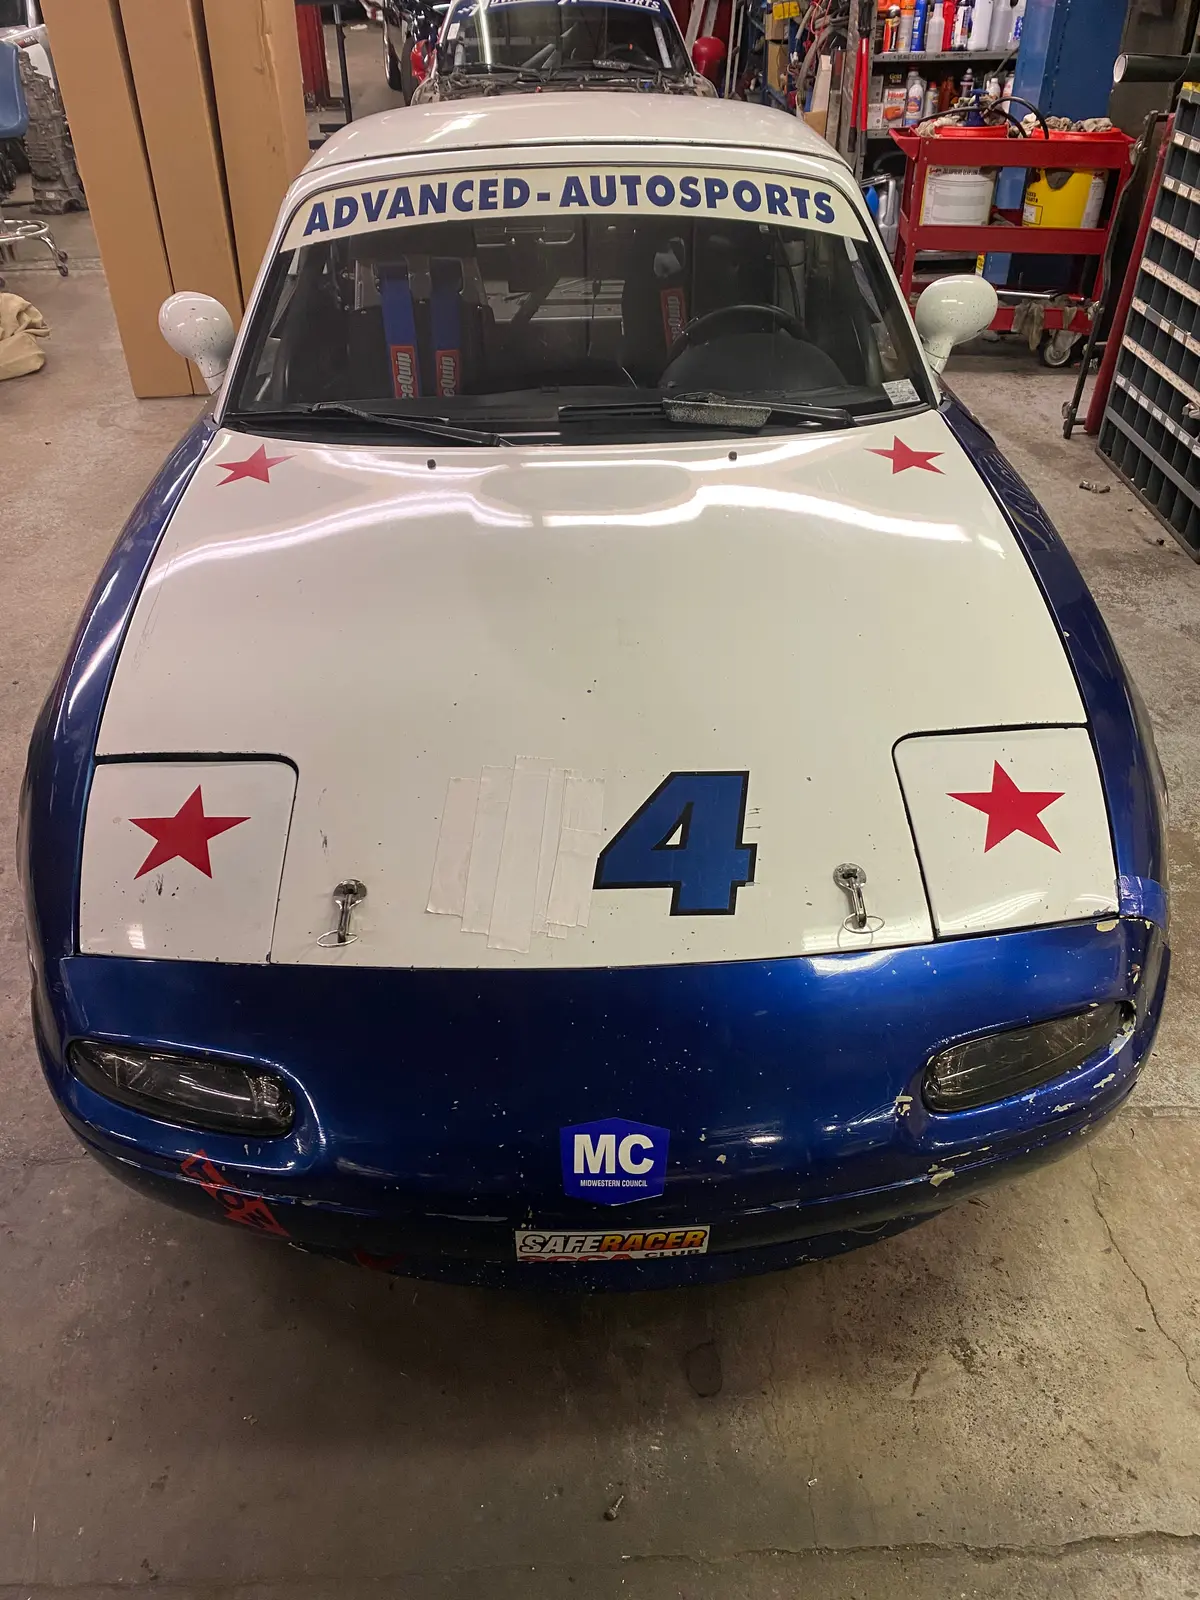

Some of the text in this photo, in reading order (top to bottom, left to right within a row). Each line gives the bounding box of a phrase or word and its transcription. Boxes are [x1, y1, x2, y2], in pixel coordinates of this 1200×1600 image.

[592, 770, 758, 916] 4
[573, 1133, 655, 1175] MC
[580, 1179, 648, 1188] MIDWESTERN COUNCIL
[518, 1229, 708, 1254] SAFERACER
